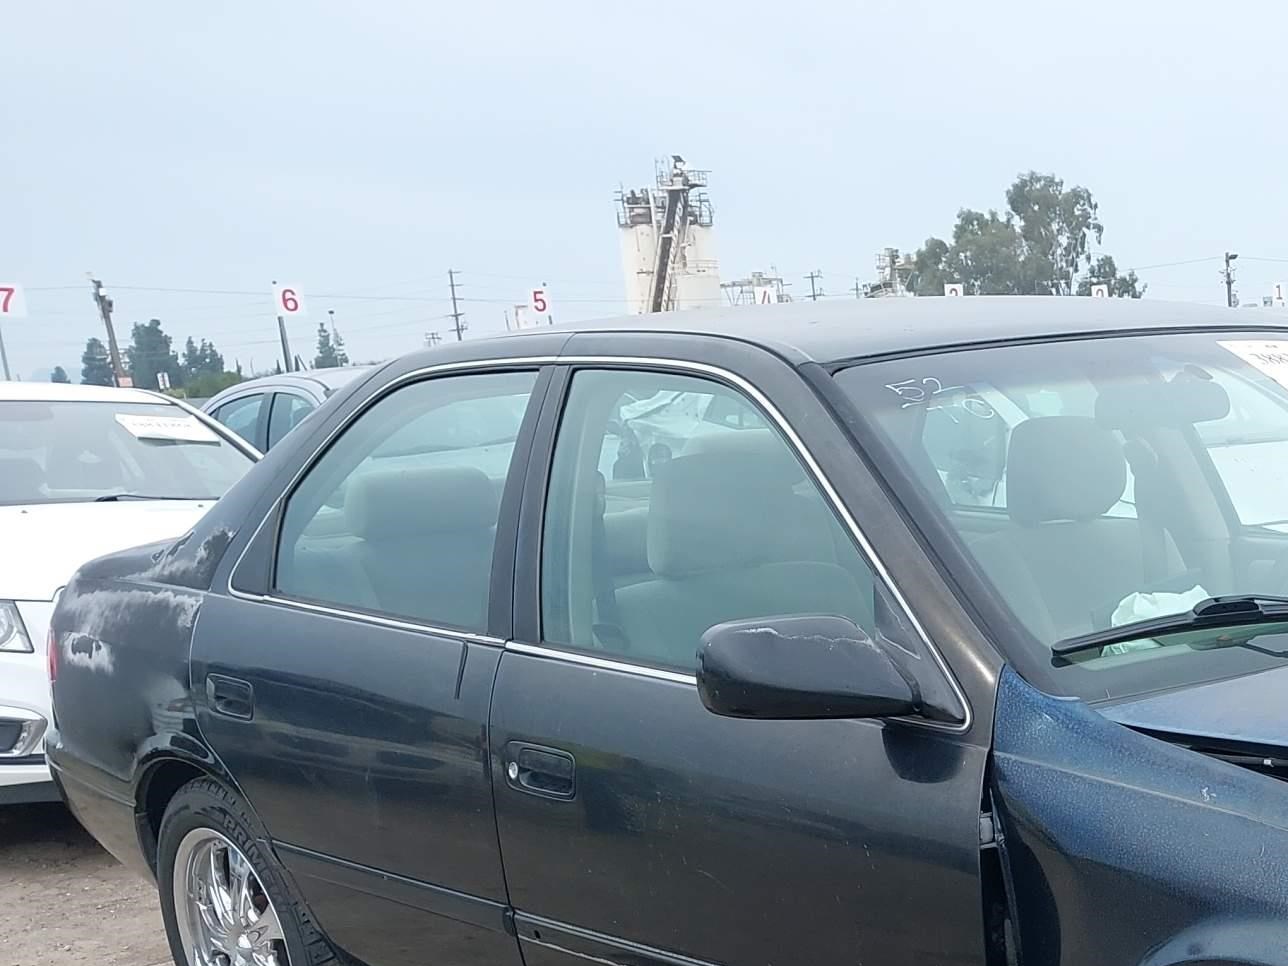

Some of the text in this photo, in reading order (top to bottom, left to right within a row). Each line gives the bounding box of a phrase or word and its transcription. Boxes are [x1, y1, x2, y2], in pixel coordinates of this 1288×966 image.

[0, 287, 15, 313] 7
[281, 288, 299, 312] 6
[532, 290, 547, 312] 5
